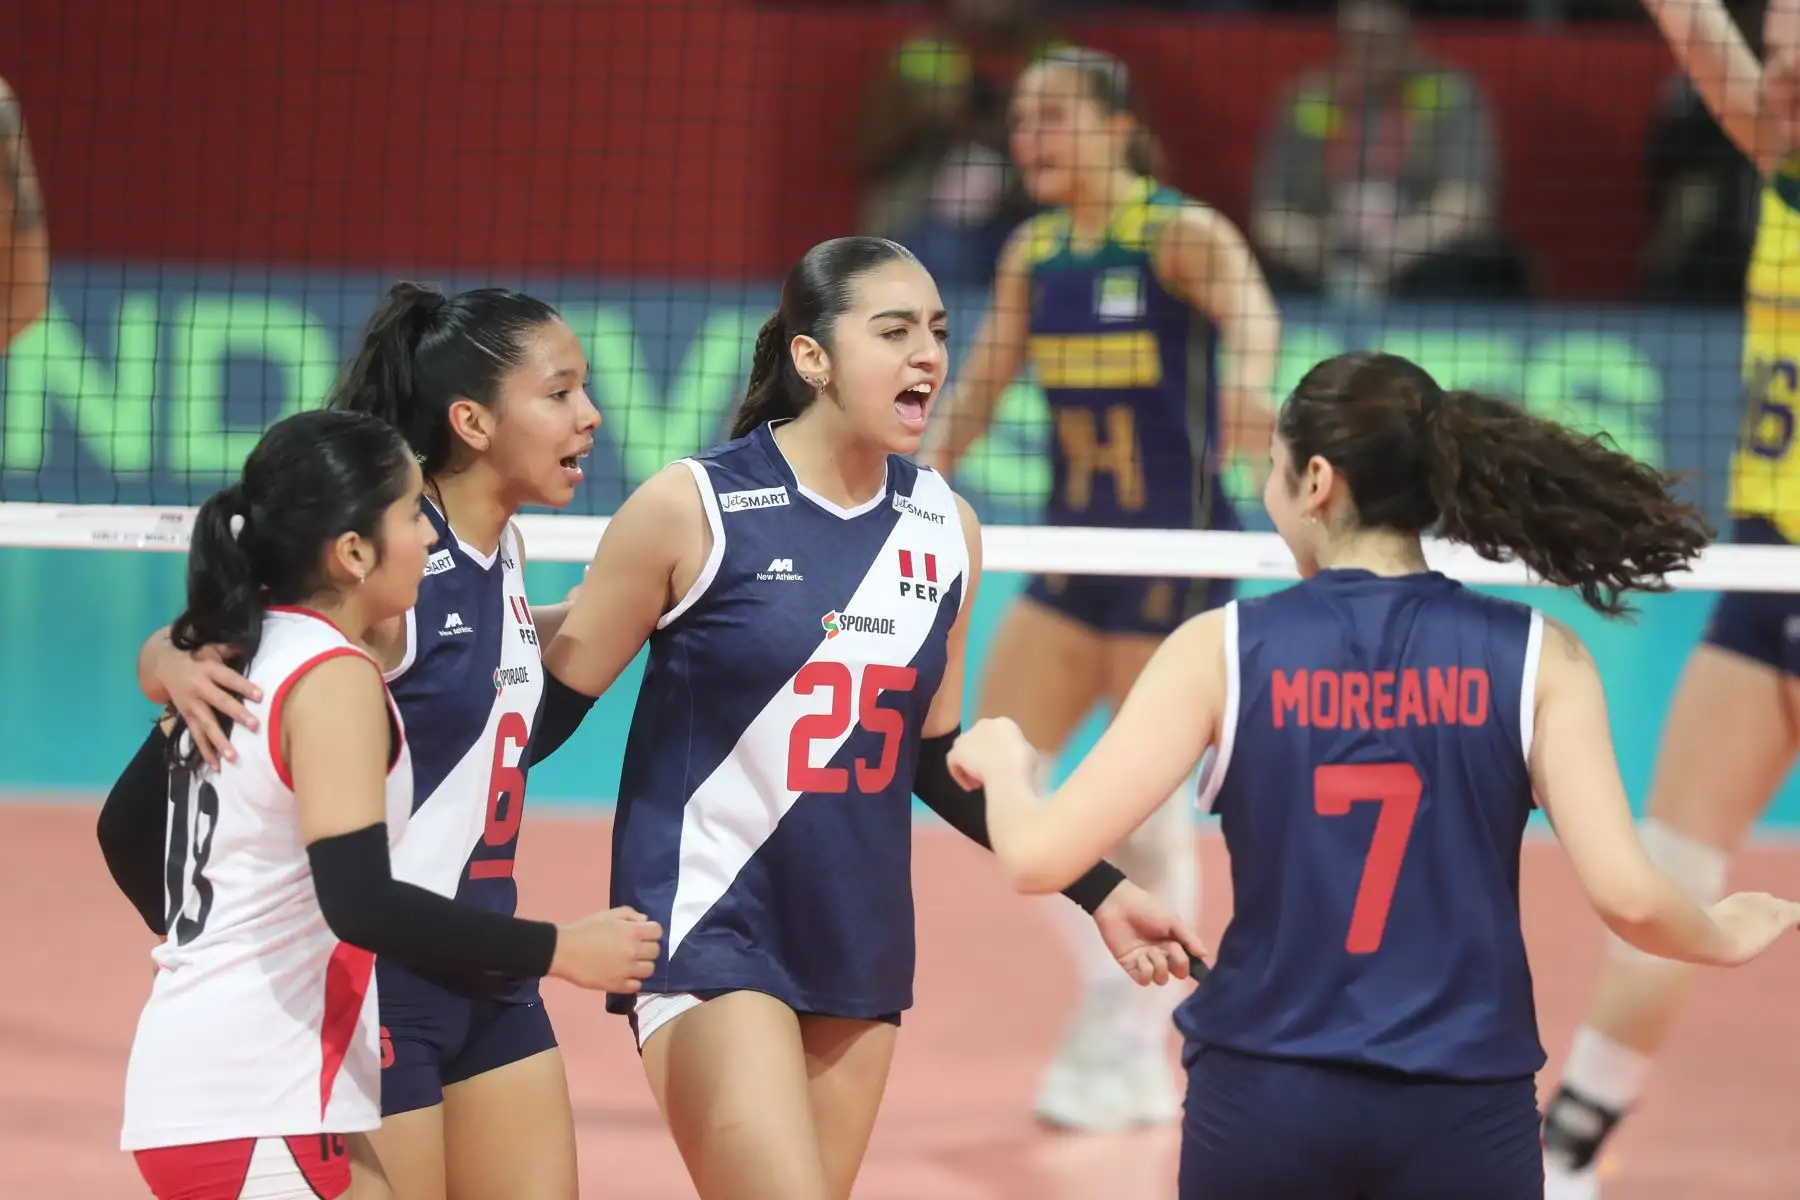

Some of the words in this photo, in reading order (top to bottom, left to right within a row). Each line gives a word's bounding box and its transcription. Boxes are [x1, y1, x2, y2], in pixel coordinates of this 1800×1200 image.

[722, 493, 786, 509] JetSMART
[894, 495, 946, 525] JetSMART
[756, 573, 774, 581] New
[776, 573, 804, 581] Athletic
[900, 581, 938, 603] PER
[519, 628, 538, 646] PER
[839, 614, 896, 635] SPORADE
[1271, 665, 1490, 731] MOREANO
[787, 661, 918, 794] 25
[483, 712, 529, 847] 6
[1313, 762, 1423, 955] 7
